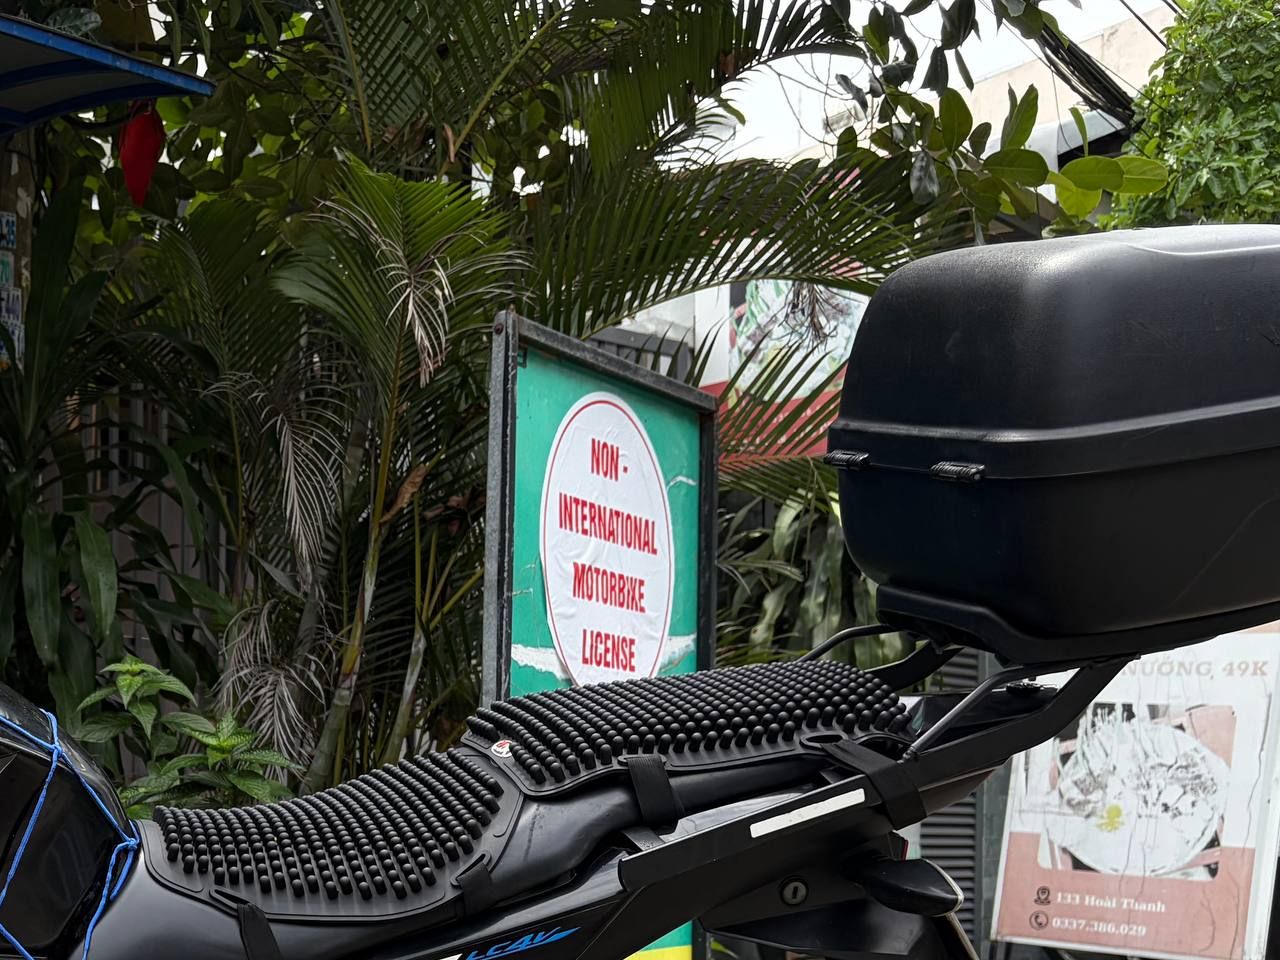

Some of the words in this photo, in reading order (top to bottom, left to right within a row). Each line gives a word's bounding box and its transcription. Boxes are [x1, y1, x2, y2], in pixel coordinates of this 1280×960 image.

[558, 492, 658, 556] INTERNATIONAL
[572, 561, 646, 614] MOTORBIKE
[581, 629, 636, 673] LICENSE
[1222, 660, 1270, 677] 49K
[1057, 891, 1081, 905] 133
[1120, 897, 1166, 913] Thanh
[1051, 916, 1147, 937] 0337.386.029
